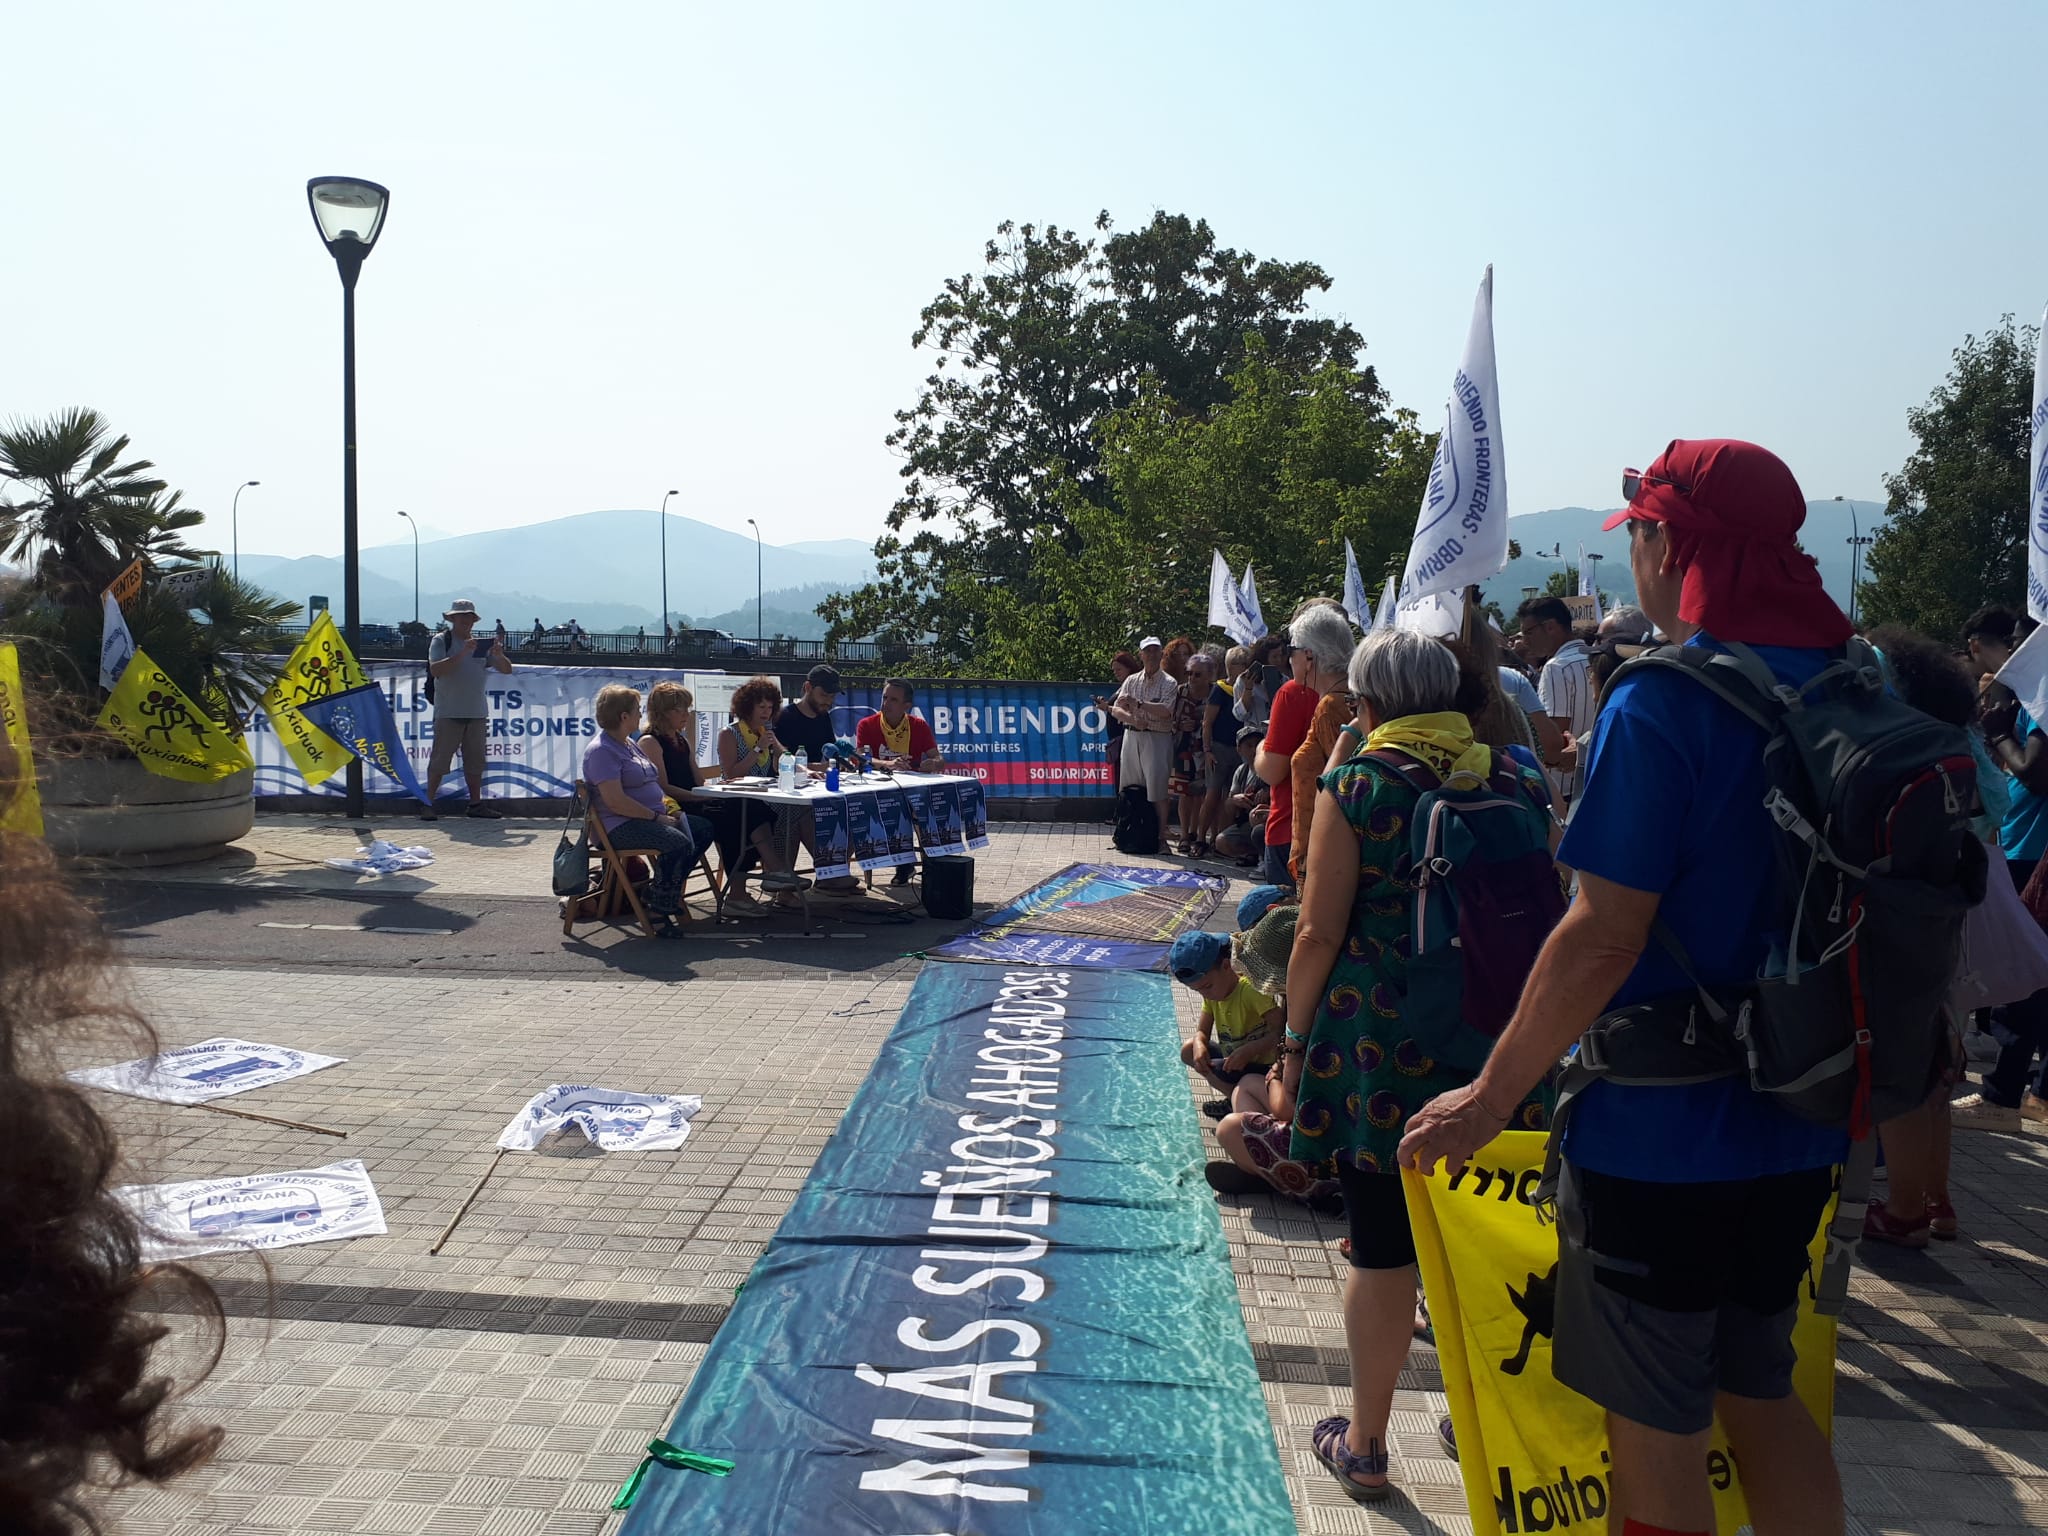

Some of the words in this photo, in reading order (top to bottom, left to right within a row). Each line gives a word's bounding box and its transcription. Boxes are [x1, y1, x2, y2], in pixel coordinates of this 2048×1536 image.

[1462, 436, 1491, 535] FRONTERAS
[1416, 537, 1463, 587] OBRIM
[113, 566, 140, 597] ENTES
[486, 690, 522, 709] TS
[271, 684, 324, 764] refuxiatuak
[404, 721, 434, 740] LE
[372, 741, 402, 783] RIGHT
[407, 748, 432, 760] RIM
[952, 740, 1021, 753] FRONTIÈRES
[1080, 742, 1107, 753] APRE
[206, 1190, 299, 1206] CARAVANA
[912, 1114, 1058, 1302] SUEÑOS
[855, 1317, 1041, 1502] MÁS
